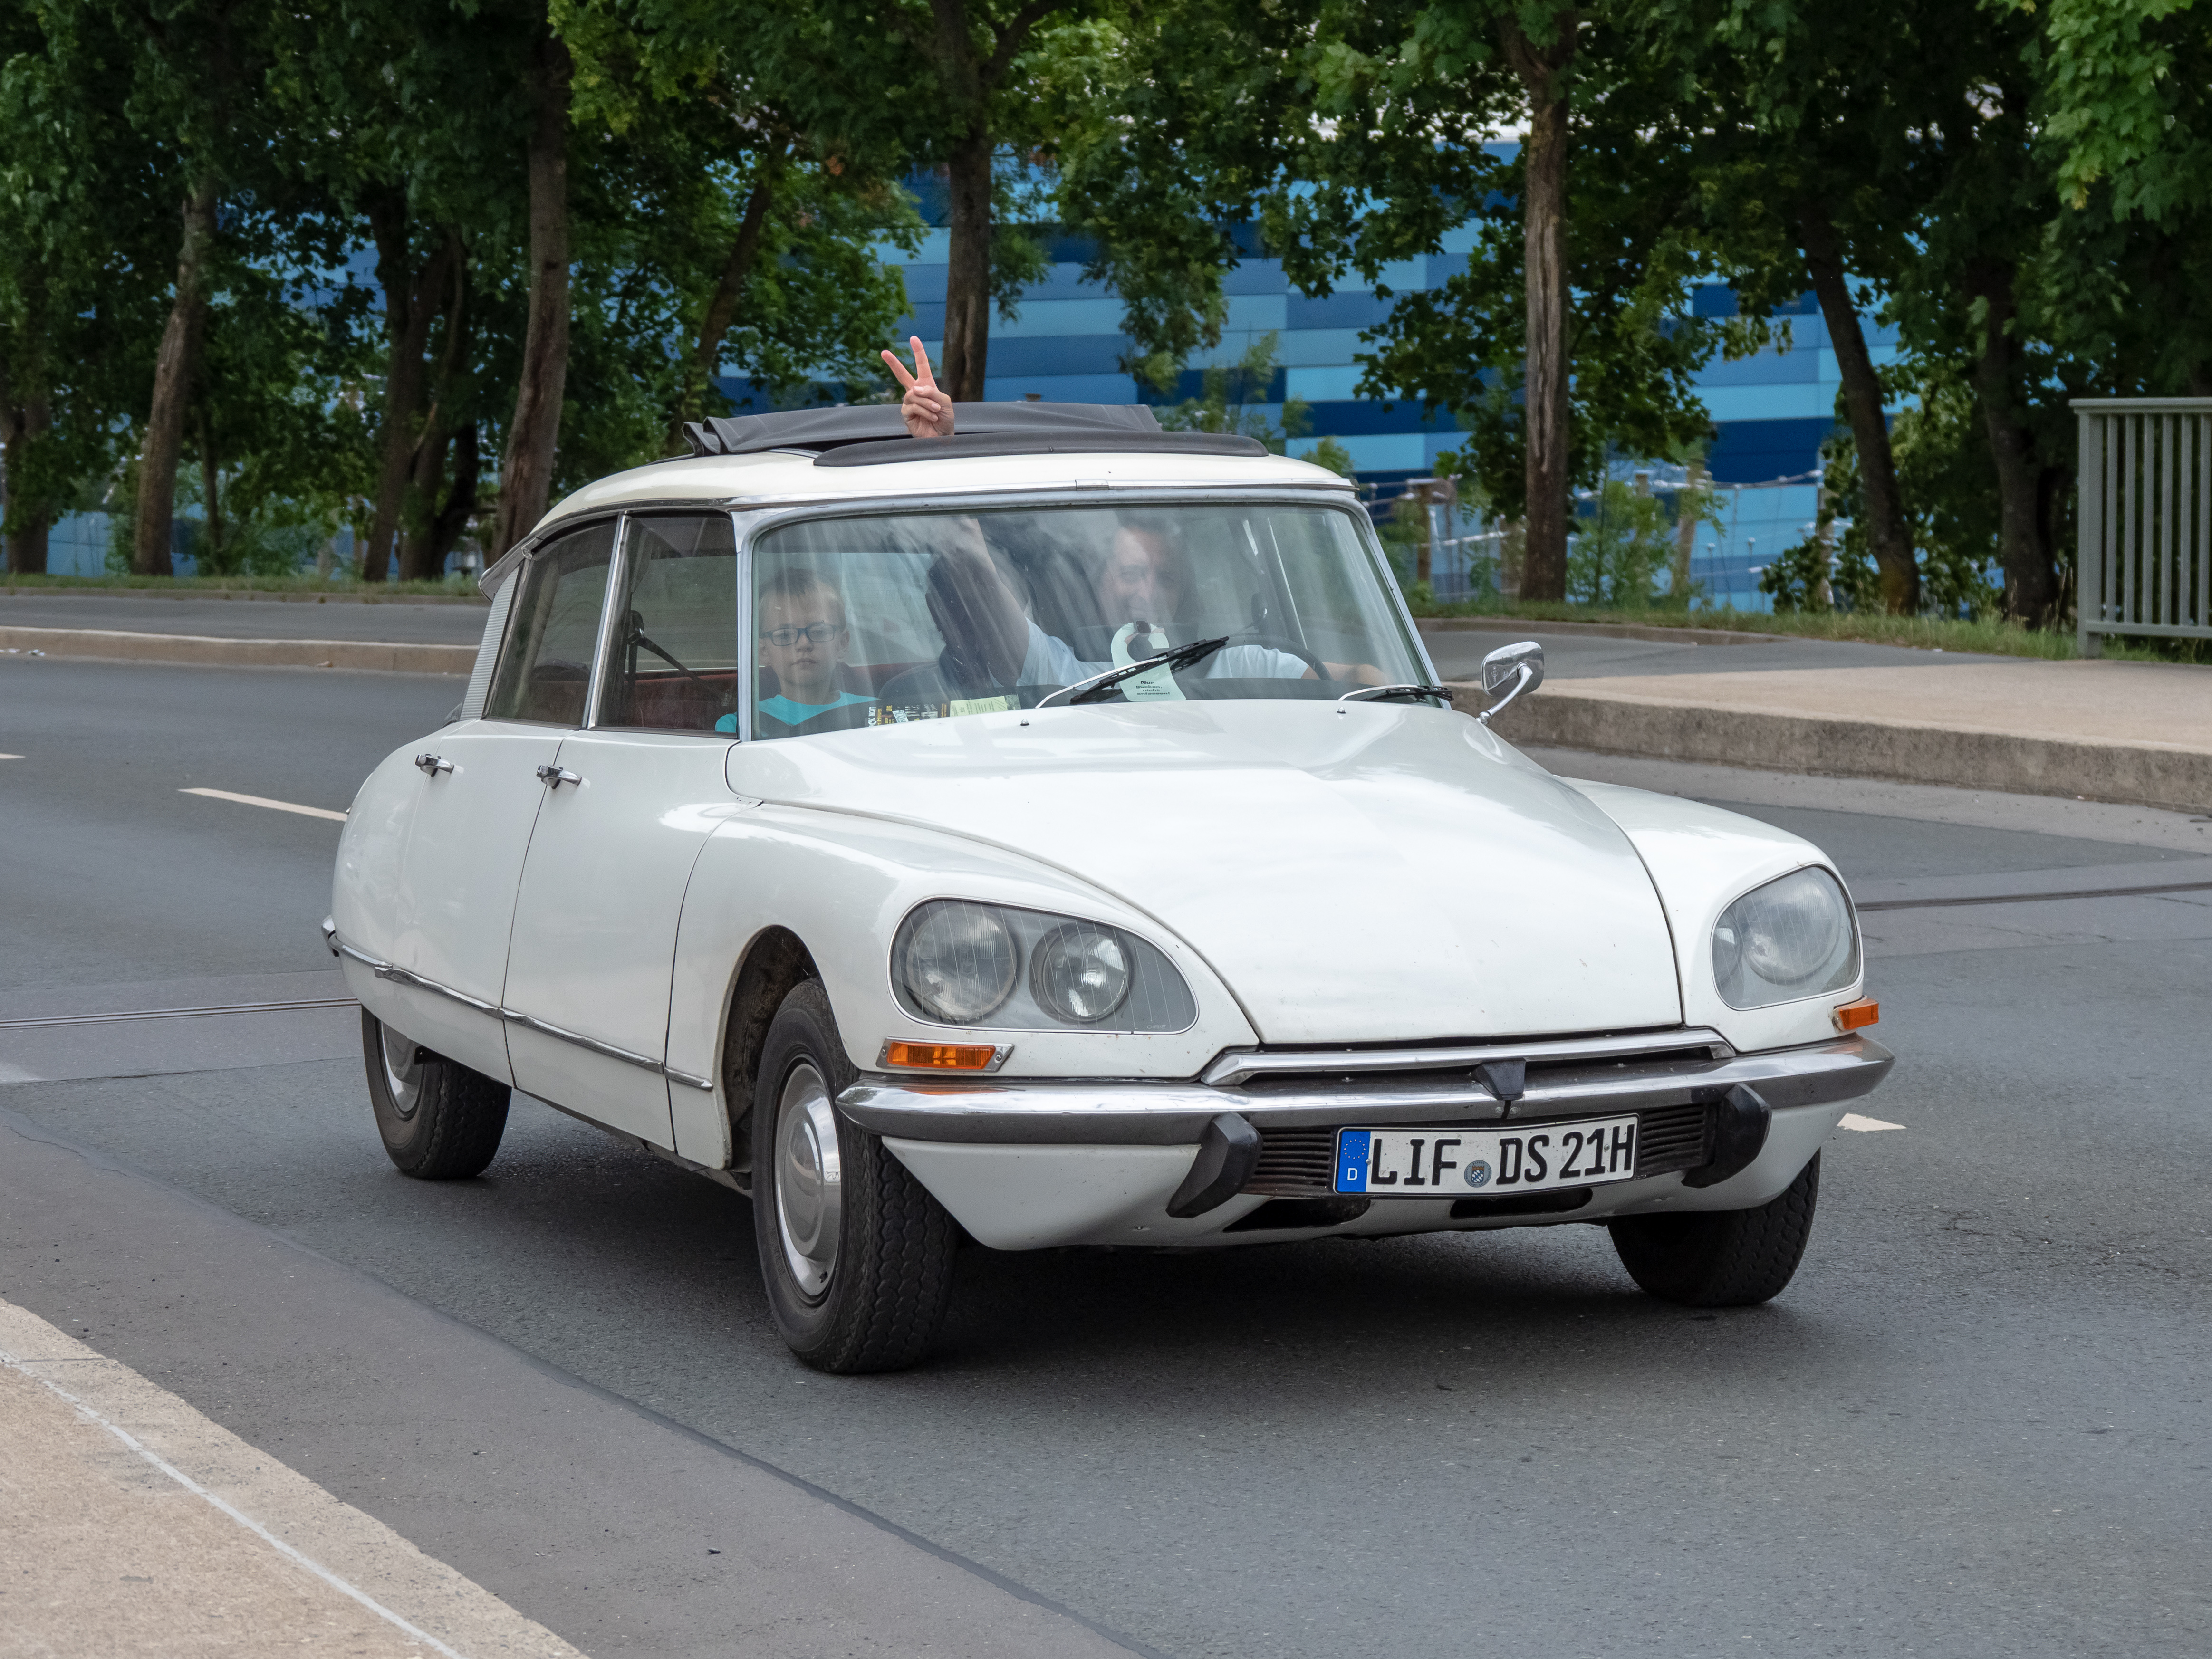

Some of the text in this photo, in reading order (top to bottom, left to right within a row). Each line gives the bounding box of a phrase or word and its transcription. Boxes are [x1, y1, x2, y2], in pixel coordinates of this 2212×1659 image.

[1346, 1167, 1358, 1181] D
[1370, 1138, 1462, 1186] LIF
[1496, 1134, 1550, 1185] DS
[1559, 1124, 1635, 1180] 21H
